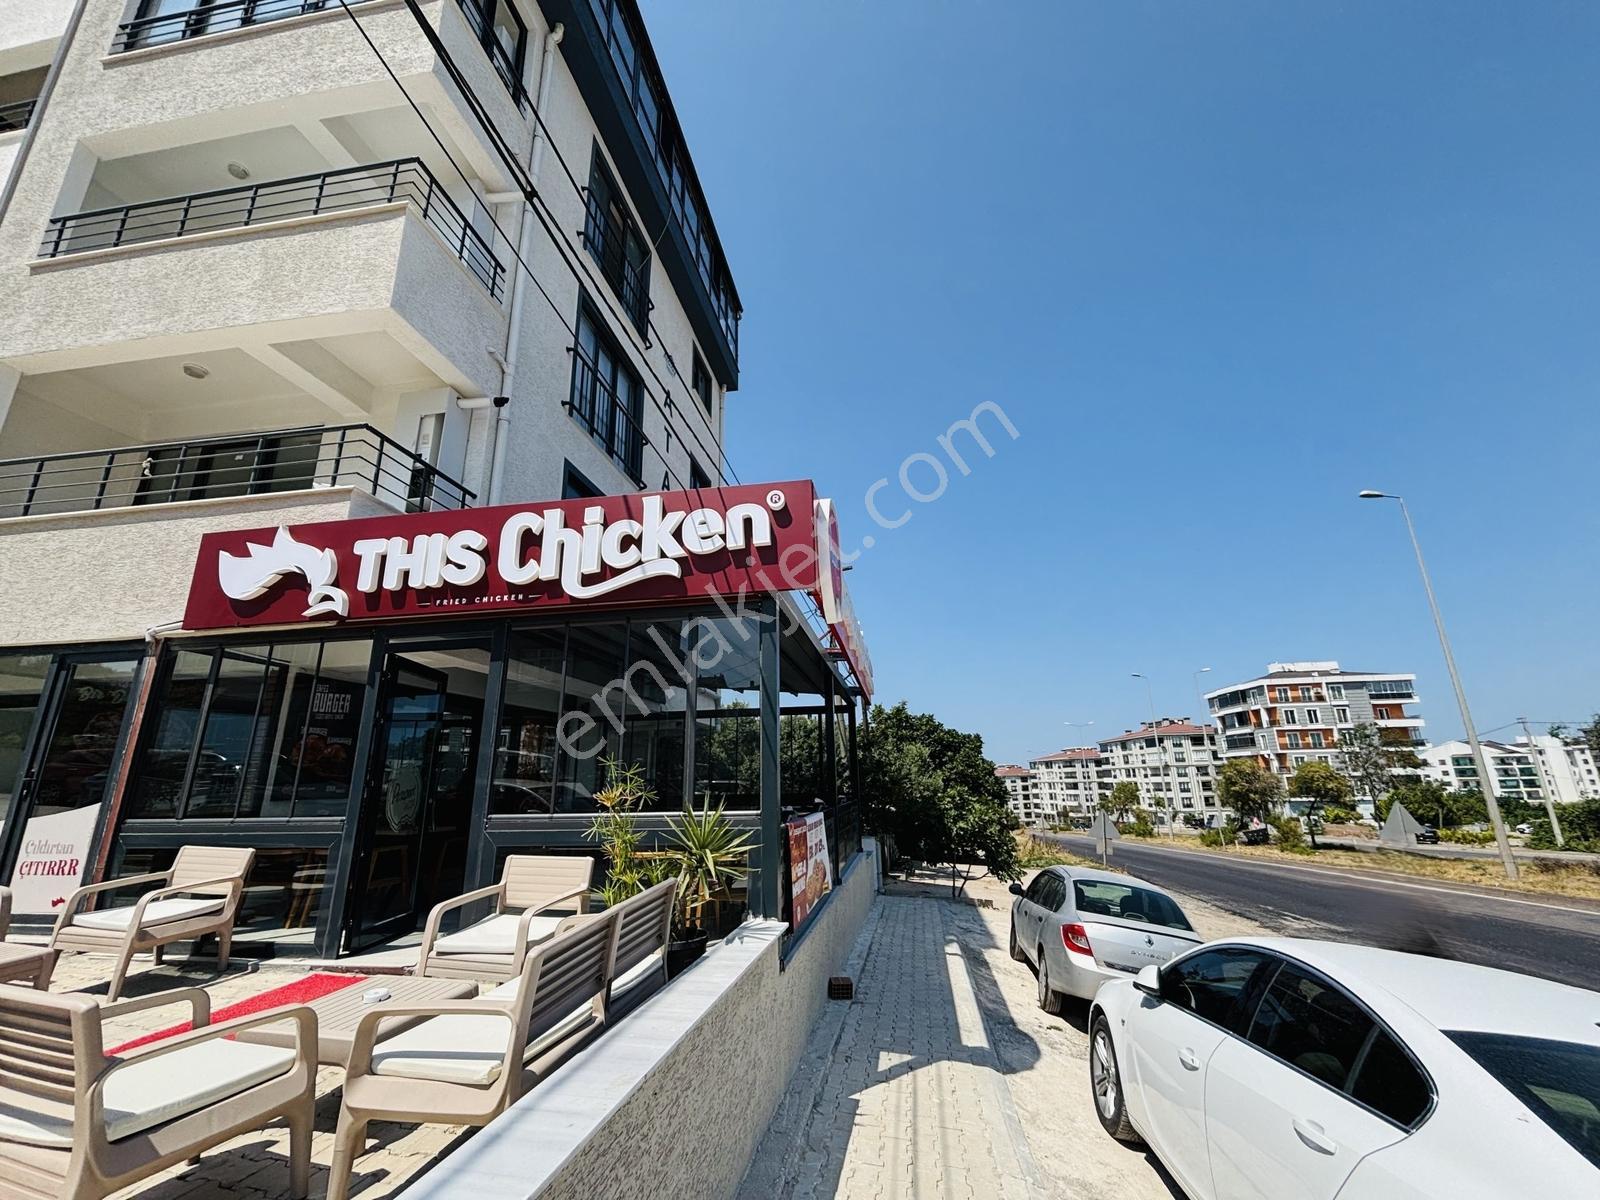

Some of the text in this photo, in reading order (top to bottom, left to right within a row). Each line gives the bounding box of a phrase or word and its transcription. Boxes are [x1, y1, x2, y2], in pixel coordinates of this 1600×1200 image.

[353, 529, 487, 593] THIS
[498, 495, 772, 599] Chicken
[435, 593, 524, 607] FRIED CHICKEN
[313, 692, 352, 713] BURGER
[25, 839, 75, 857] Çıldırtan
[19, 858, 80, 880] ÇITIRRR
